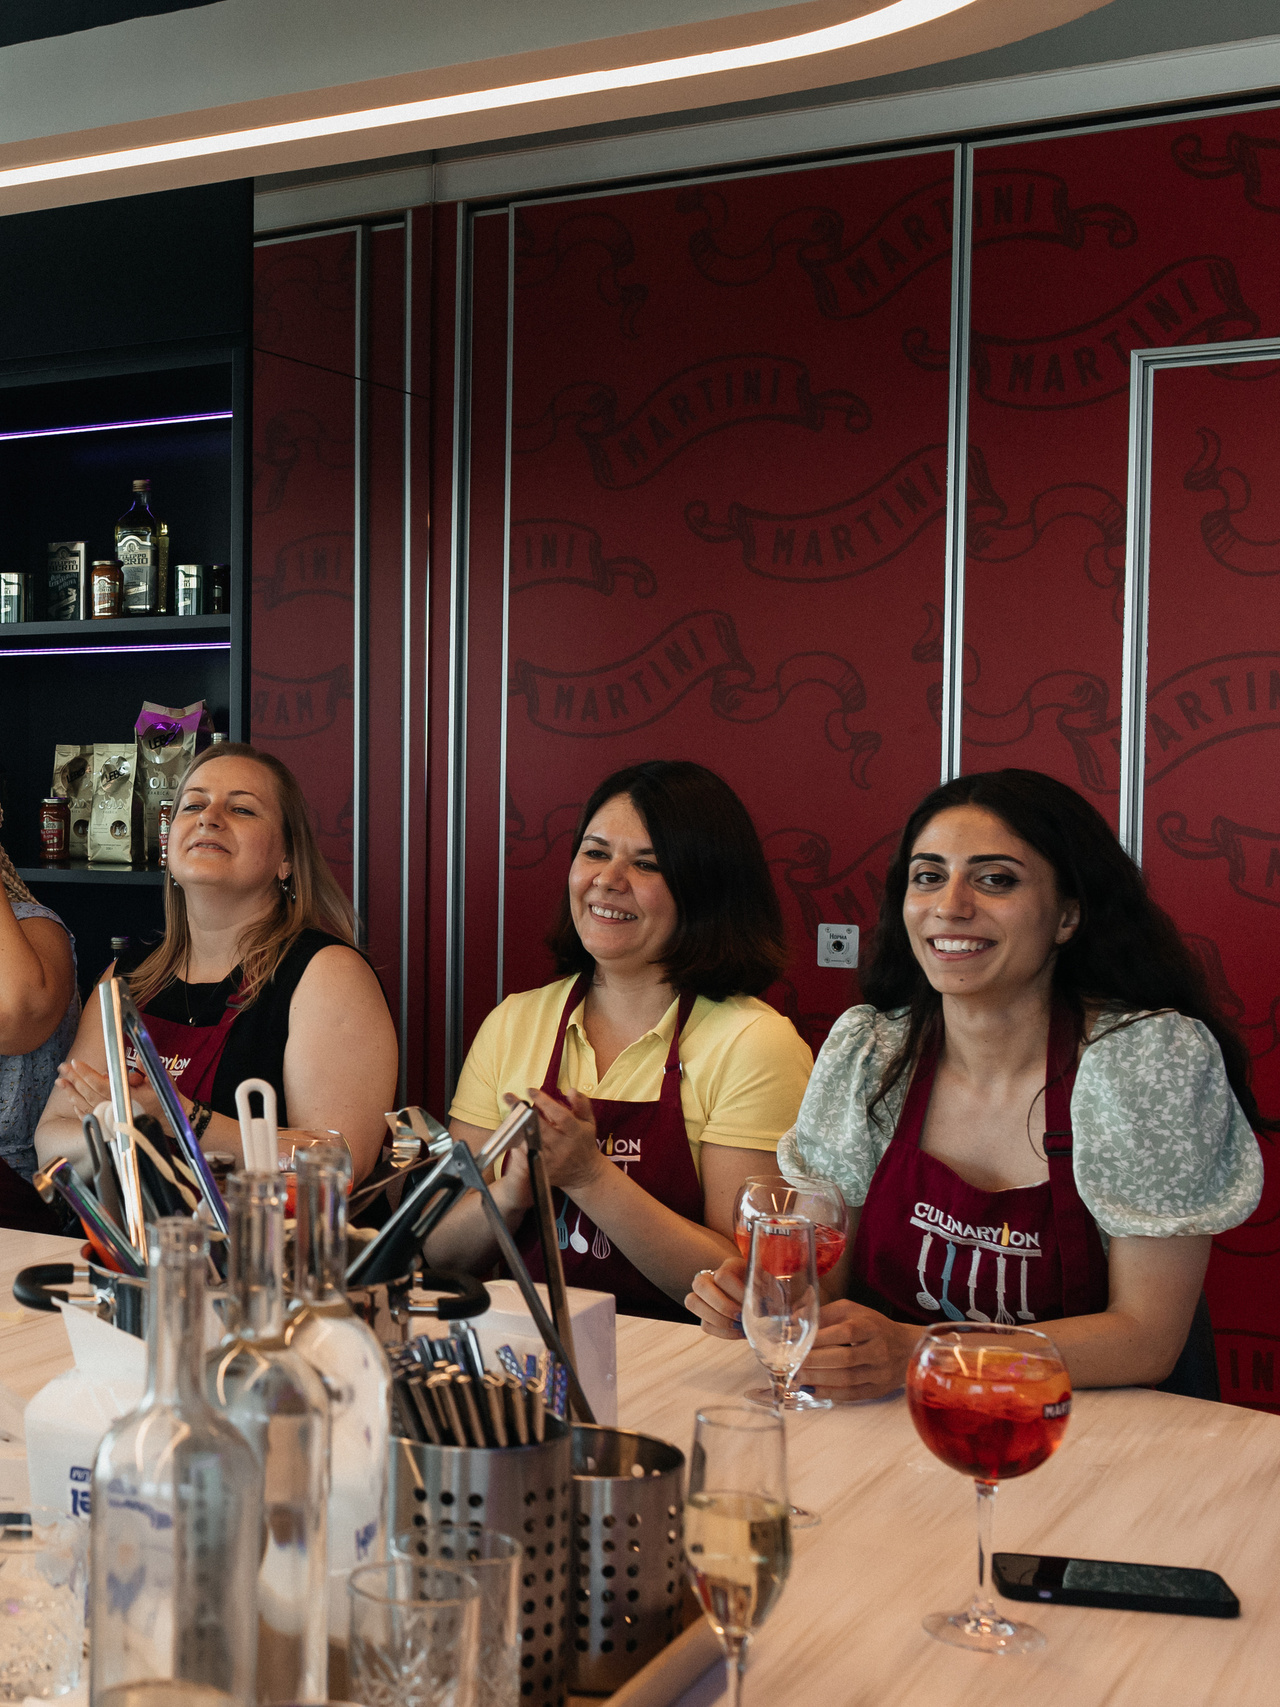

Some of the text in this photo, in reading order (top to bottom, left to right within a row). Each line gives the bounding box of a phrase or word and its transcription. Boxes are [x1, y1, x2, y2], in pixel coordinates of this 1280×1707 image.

[845, 183, 1036, 297] MARTINI
[1008, 276, 1198, 393] MARTINI
[623, 365, 782, 469] MARTINI
[771, 461, 944, 568] MARTINI
[553, 628, 708, 724] MARTINI
